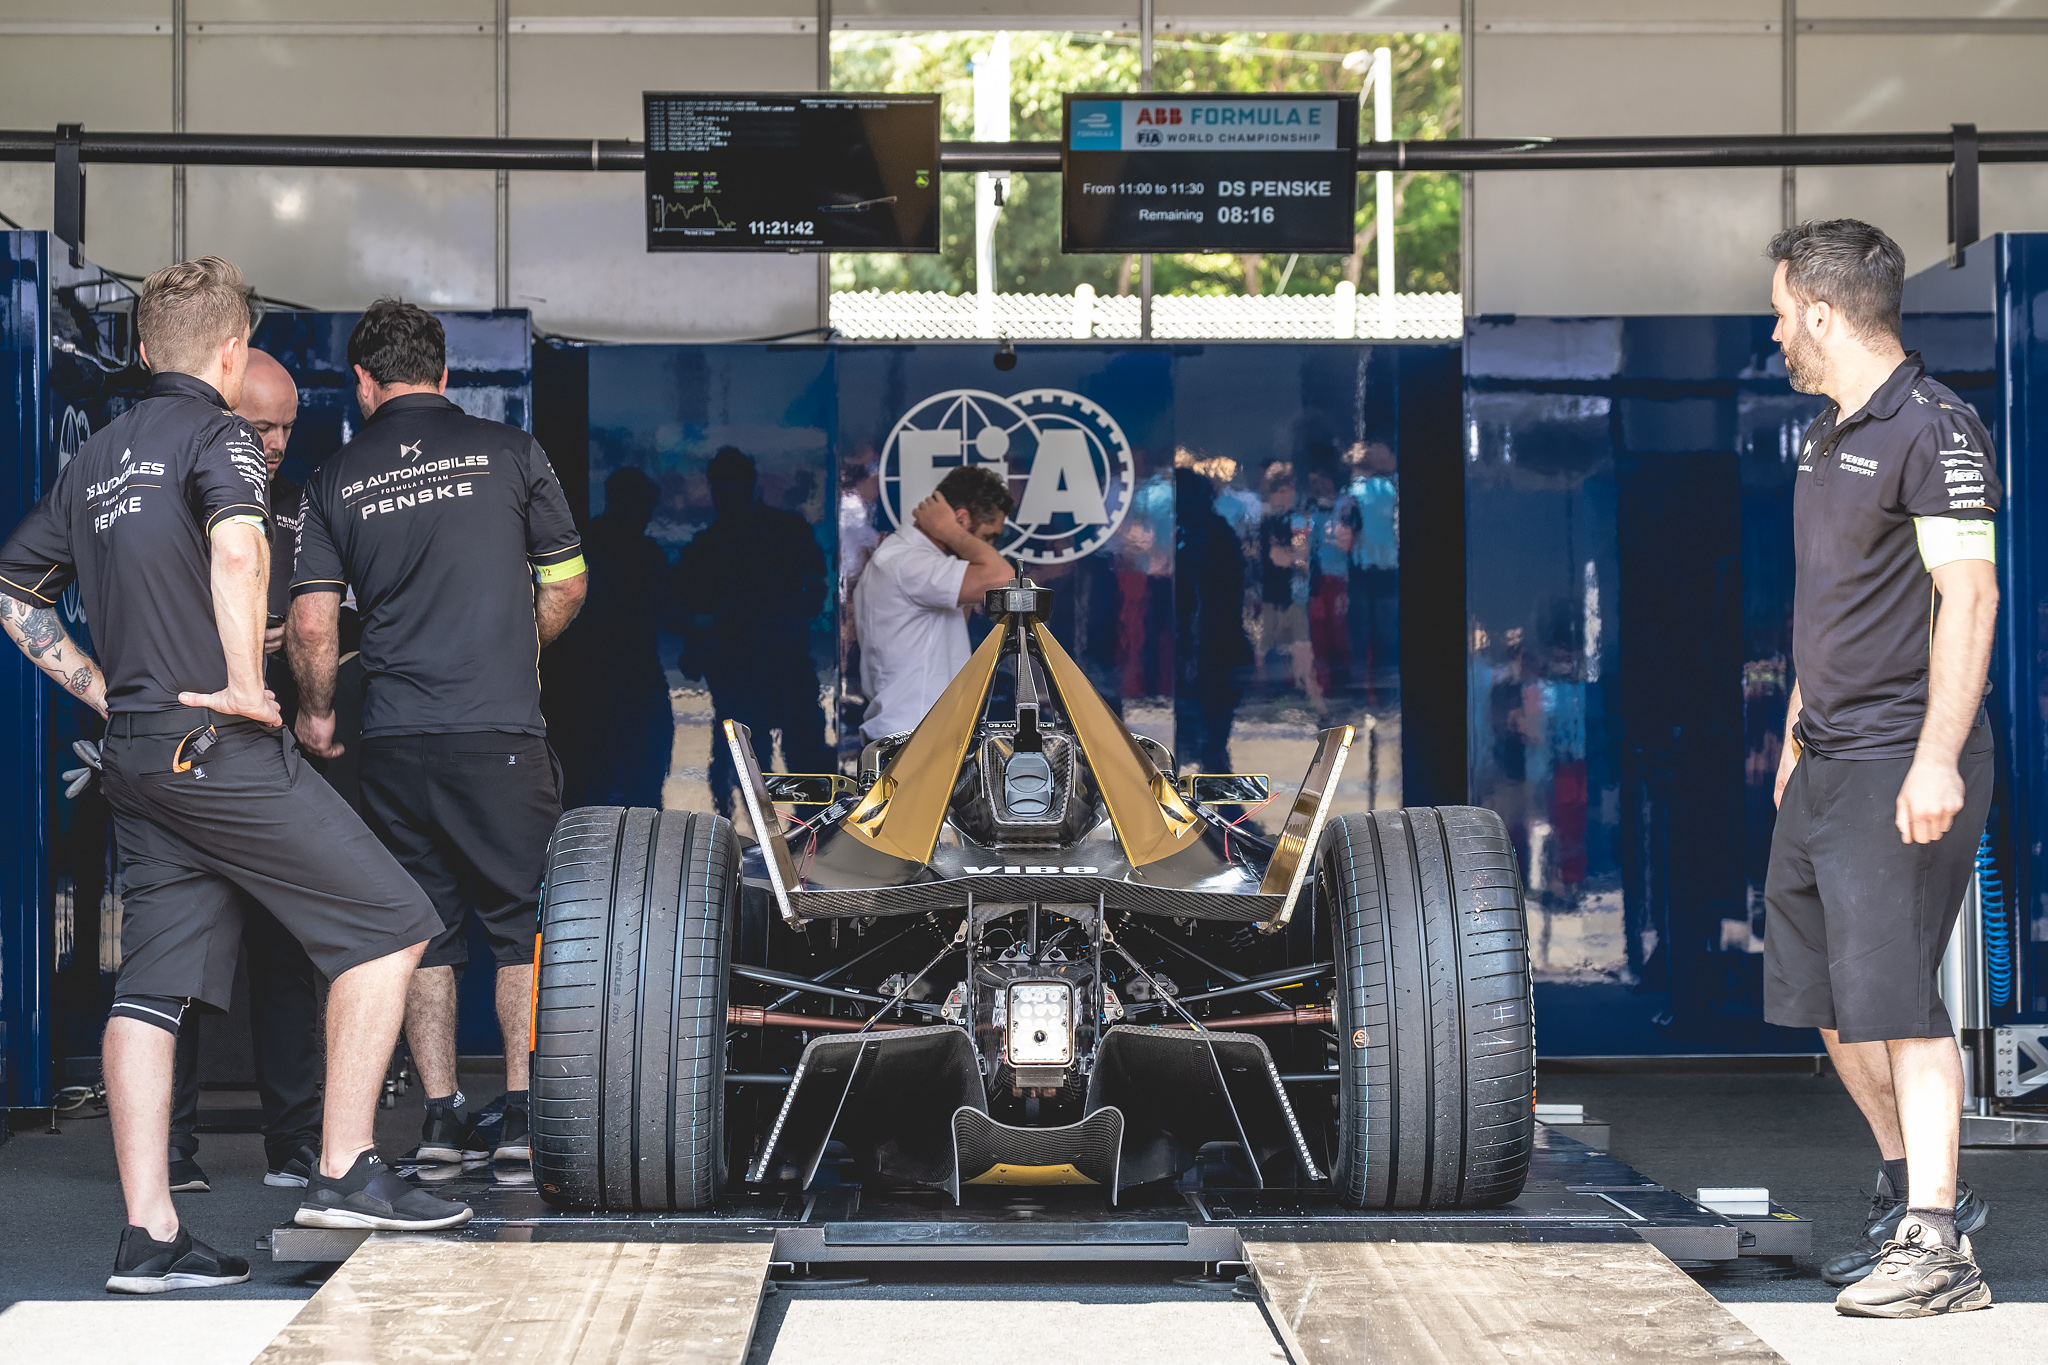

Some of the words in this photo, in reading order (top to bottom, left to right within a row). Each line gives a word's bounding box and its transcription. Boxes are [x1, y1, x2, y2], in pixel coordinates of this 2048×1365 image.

[1136, 107, 1183, 126] ABB
[1190, 107, 1301, 126] FORMULA
[1308, 107, 1321, 126] E
[1167, 133, 1214, 143] WORLD
[1218, 133, 1321, 143] CHAMPIONSHIP
[1083, 183, 1115, 195] From
[1118, 183, 1153, 195] 11:00
[1155, 183, 1168, 195] to
[1171, 183, 1205, 195] 11:30
[1218, 181, 1246, 197] DS
[1251, 181, 1331, 197] PENSKE
[1139, 209, 1204, 223] Remaining
[1218, 207, 1275, 223] 08:16
[748, 221, 815, 235] 11:21:42
[1840, 452, 1879, 470] PENSKE
[341, 480, 365, 500] DS
[366, 455, 490, 489] AUTOMOBILES
[1839, 462, 1877, 477] AUTOSPORT
[96, 461, 166, 496] AUTOLES
[381, 482, 417, 495] FORMULA
[427, 474, 449, 484] TEAM
[361, 482, 474, 520] PENSKE
